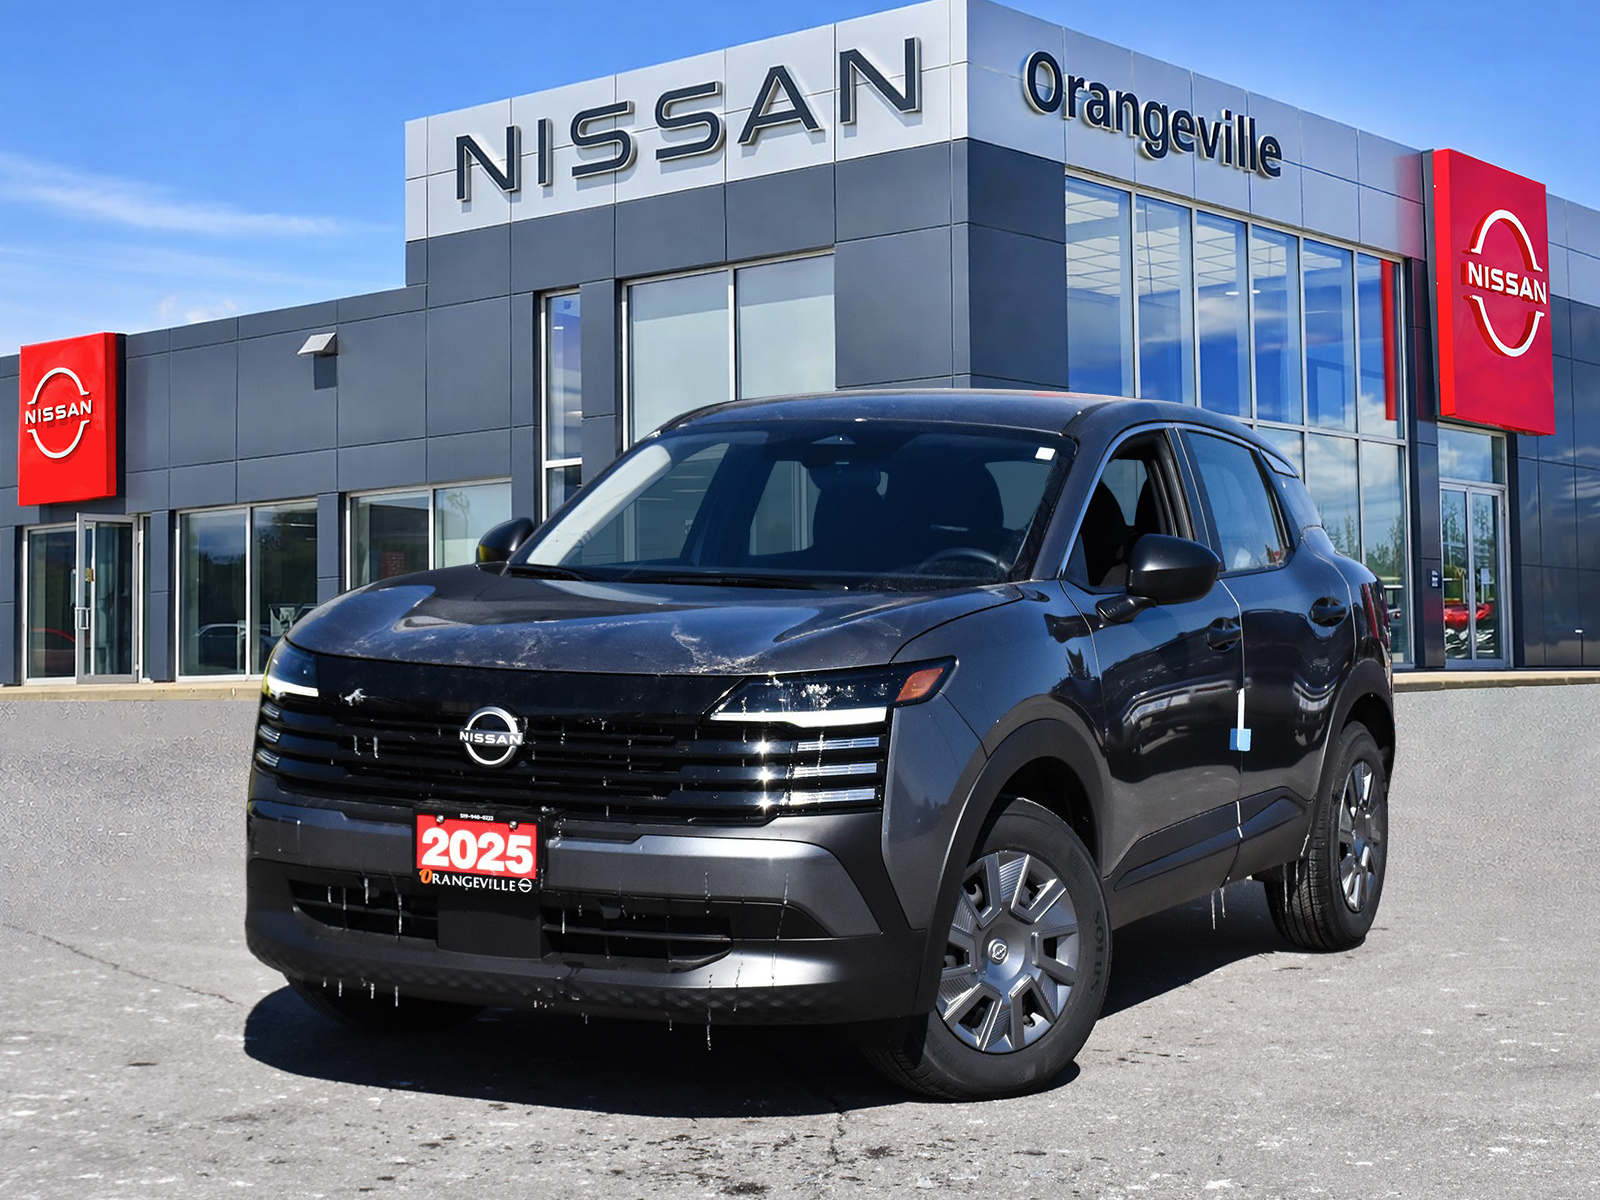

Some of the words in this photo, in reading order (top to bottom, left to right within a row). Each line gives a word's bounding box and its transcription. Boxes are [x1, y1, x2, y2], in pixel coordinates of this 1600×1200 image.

[455, 37, 922, 201] NISSAN
[1023, 50, 1283, 178] Orangeville
[1467, 261, 1547, 305] NISSAN
[25, 400, 92, 425] NISSAN
[459, 731, 522, 745] NISSAN
[421, 827, 533, 874] 2025
[419, 868, 516, 892] ORANGEVILLE
